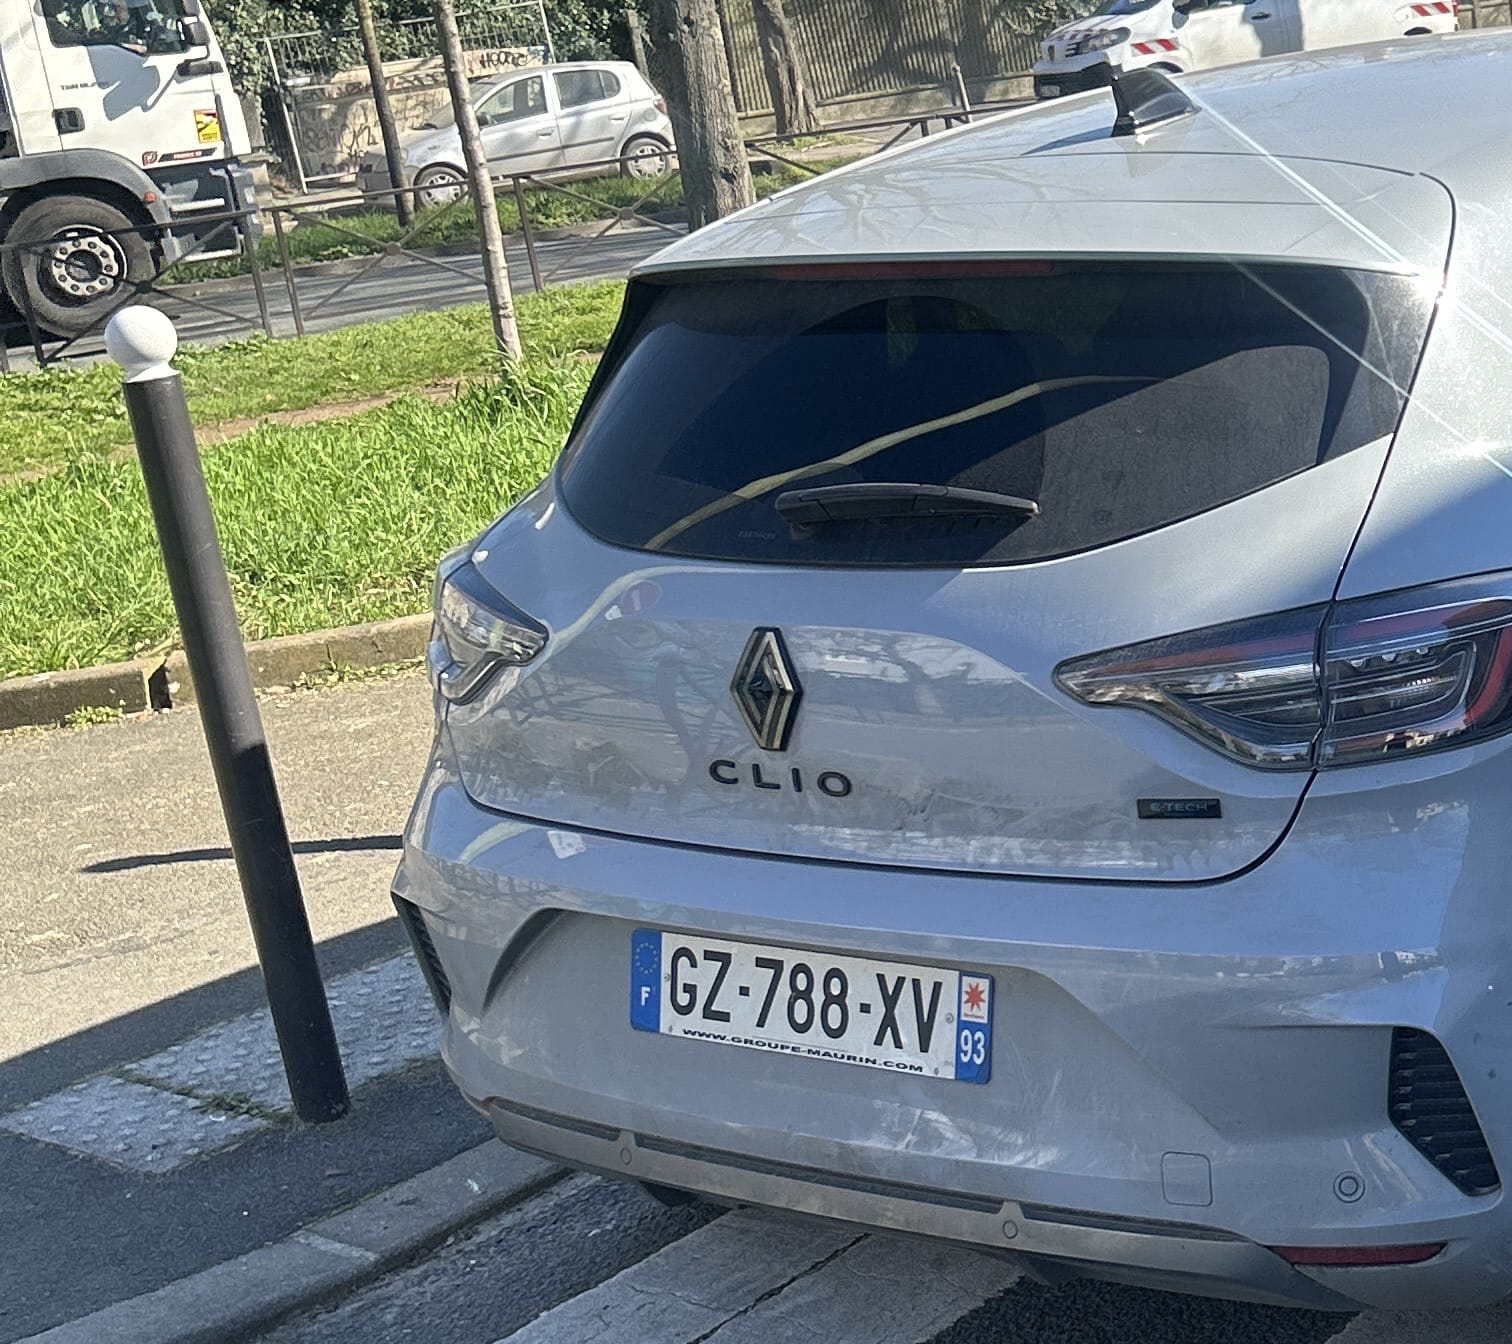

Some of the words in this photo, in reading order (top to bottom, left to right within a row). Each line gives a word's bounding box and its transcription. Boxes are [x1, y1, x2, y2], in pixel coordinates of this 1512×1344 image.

[709, 759, 852, 797] CLIO
[1150, 801, 1208, 812] E-TECH
[641, 985, 651, 1007] F
[670, 946, 943, 1053] GZ-788-XV
[960, 1029, 985, 1065] 93
